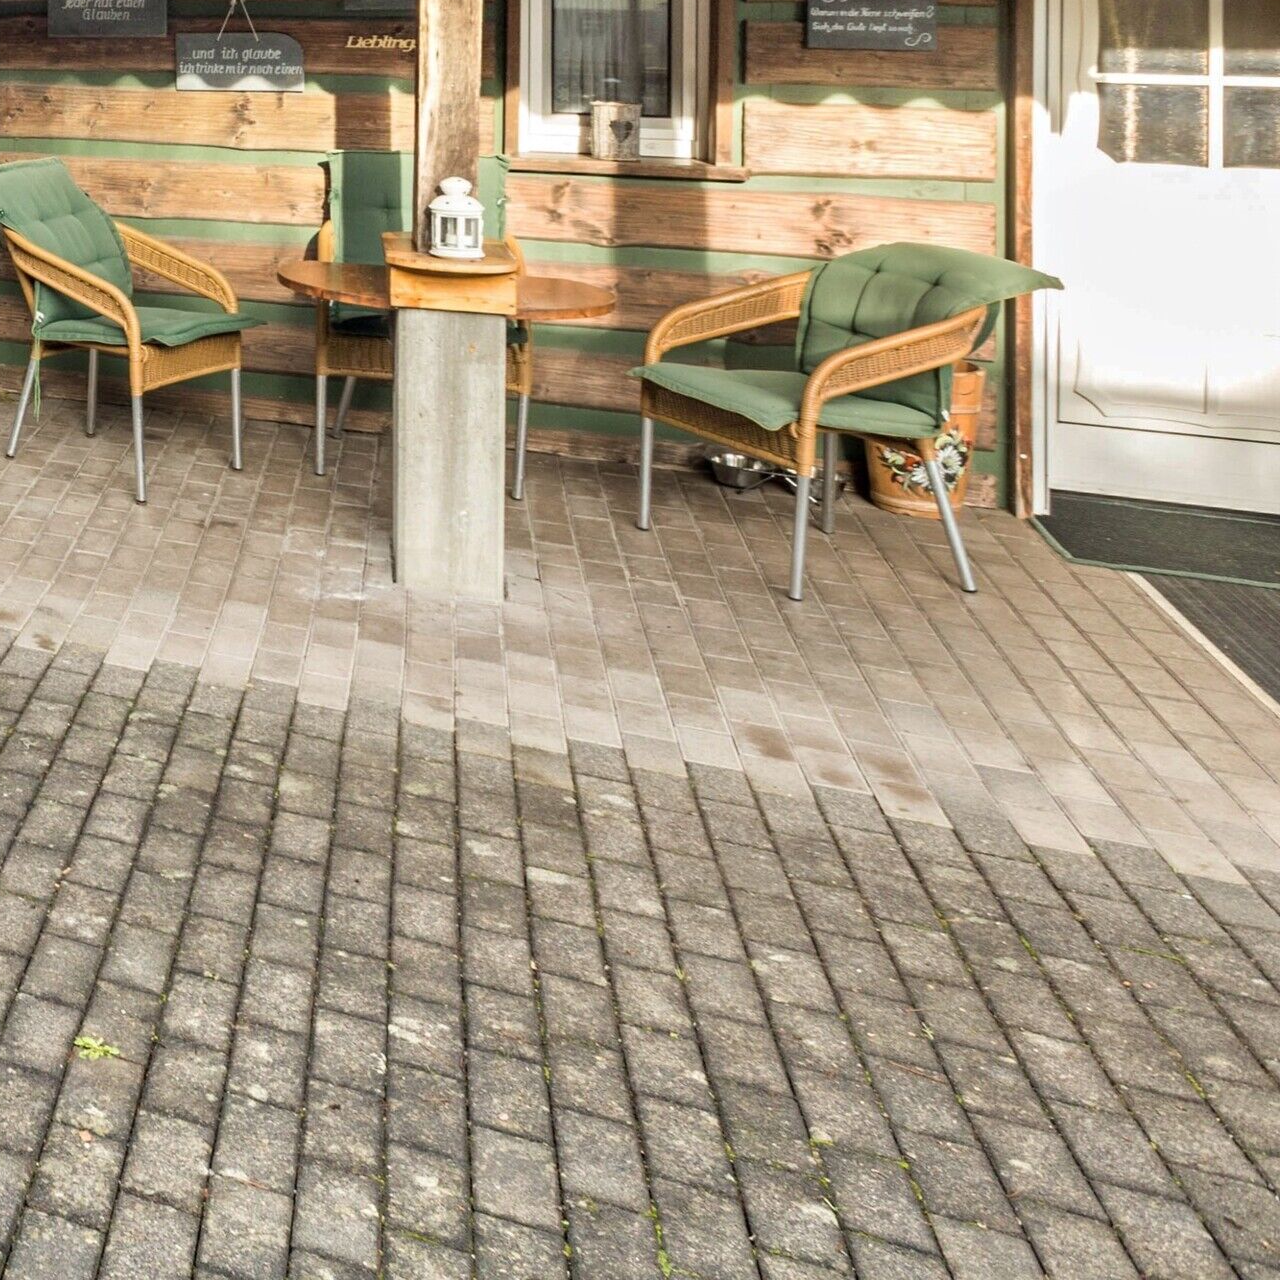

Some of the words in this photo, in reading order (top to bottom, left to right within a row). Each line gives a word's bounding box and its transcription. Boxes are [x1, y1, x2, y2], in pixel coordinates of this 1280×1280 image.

[344, 35, 417, 53] Liebling
[221, 46, 239, 60] ich
[241, 48, 282, 62] glaube
[179, 61, 195, 74] ich
[195, 62, 224, 74] trinke
[225, 62, 248, 74] mir
[248, 64, 273, 74] noch
[274, 62, 303, 74] einen
